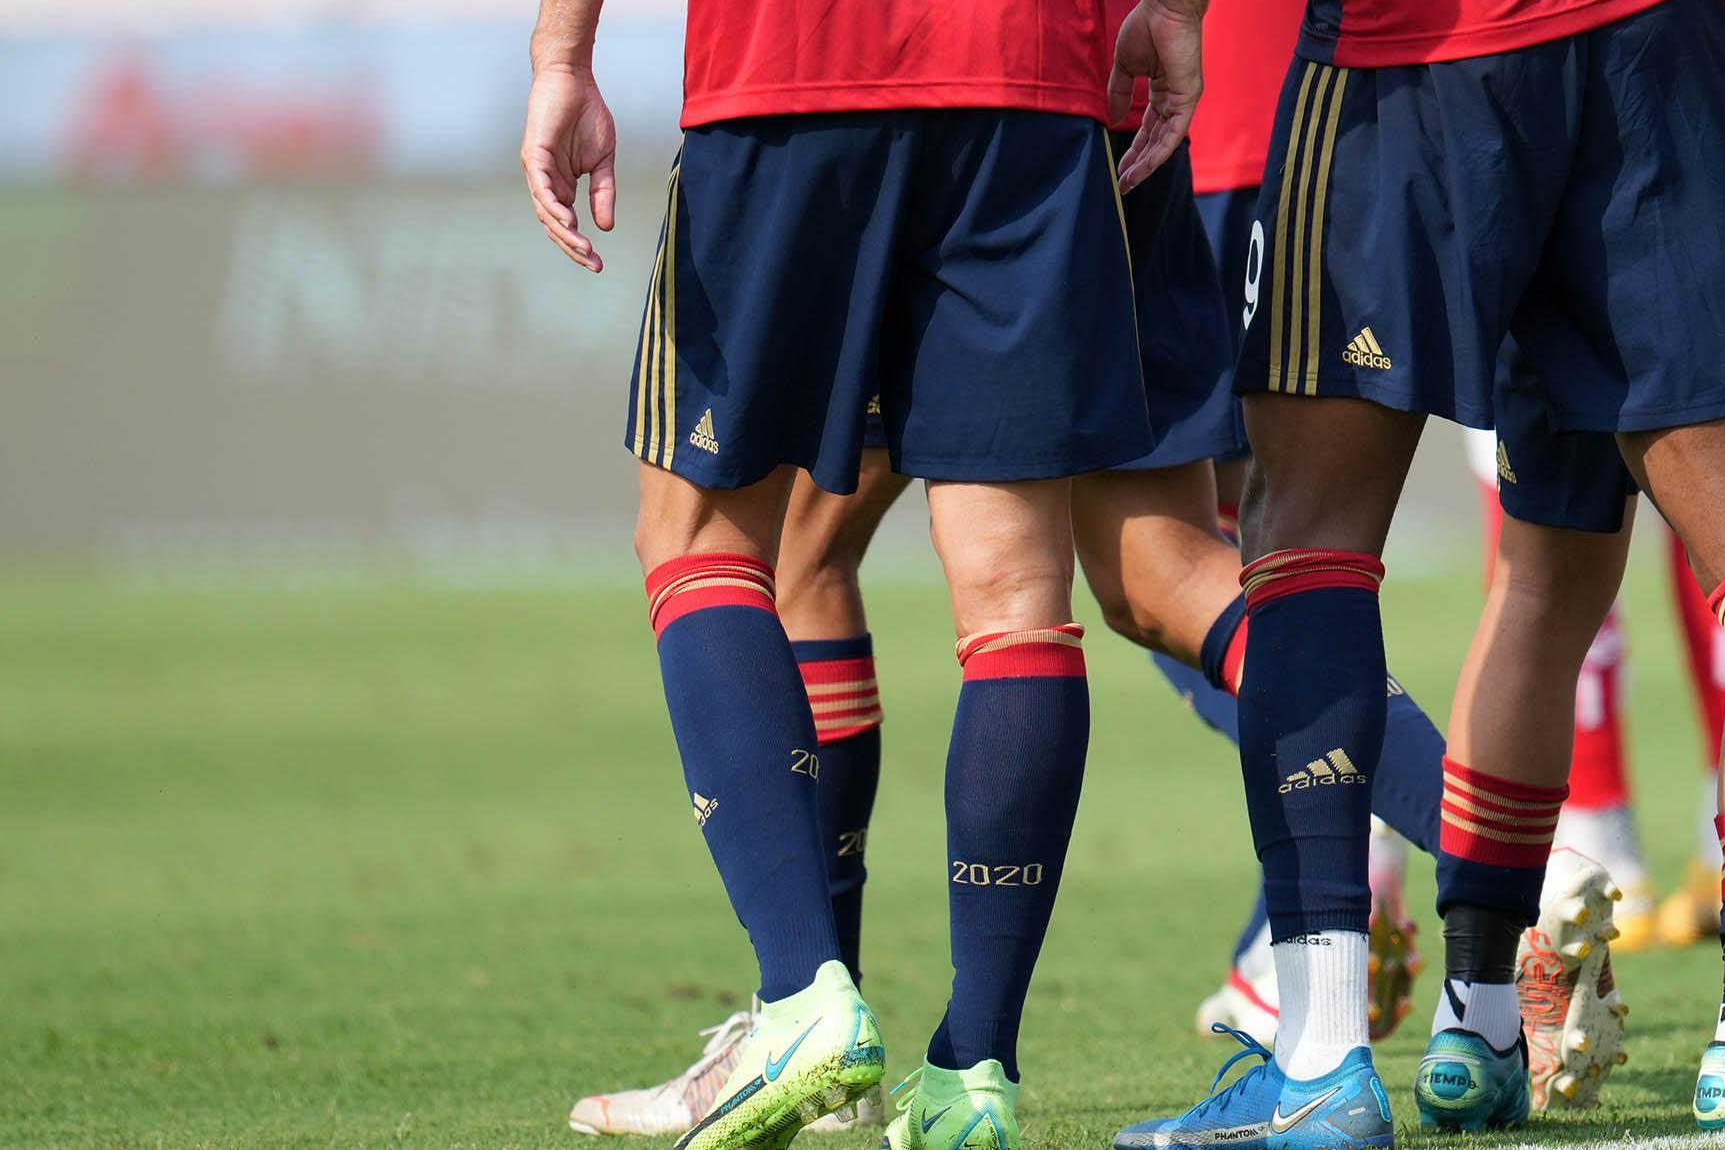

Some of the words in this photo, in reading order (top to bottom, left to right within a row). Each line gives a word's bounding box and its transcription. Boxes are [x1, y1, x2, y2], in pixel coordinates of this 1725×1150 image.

[1243, 220, 1264, 330] 9
[1342, 350, 1391, 369] adidas
[690, 432, 719, 454] adidas
[1278, 773, 1366, 793] adidas
[953, 861, 1044, 886] 2020
